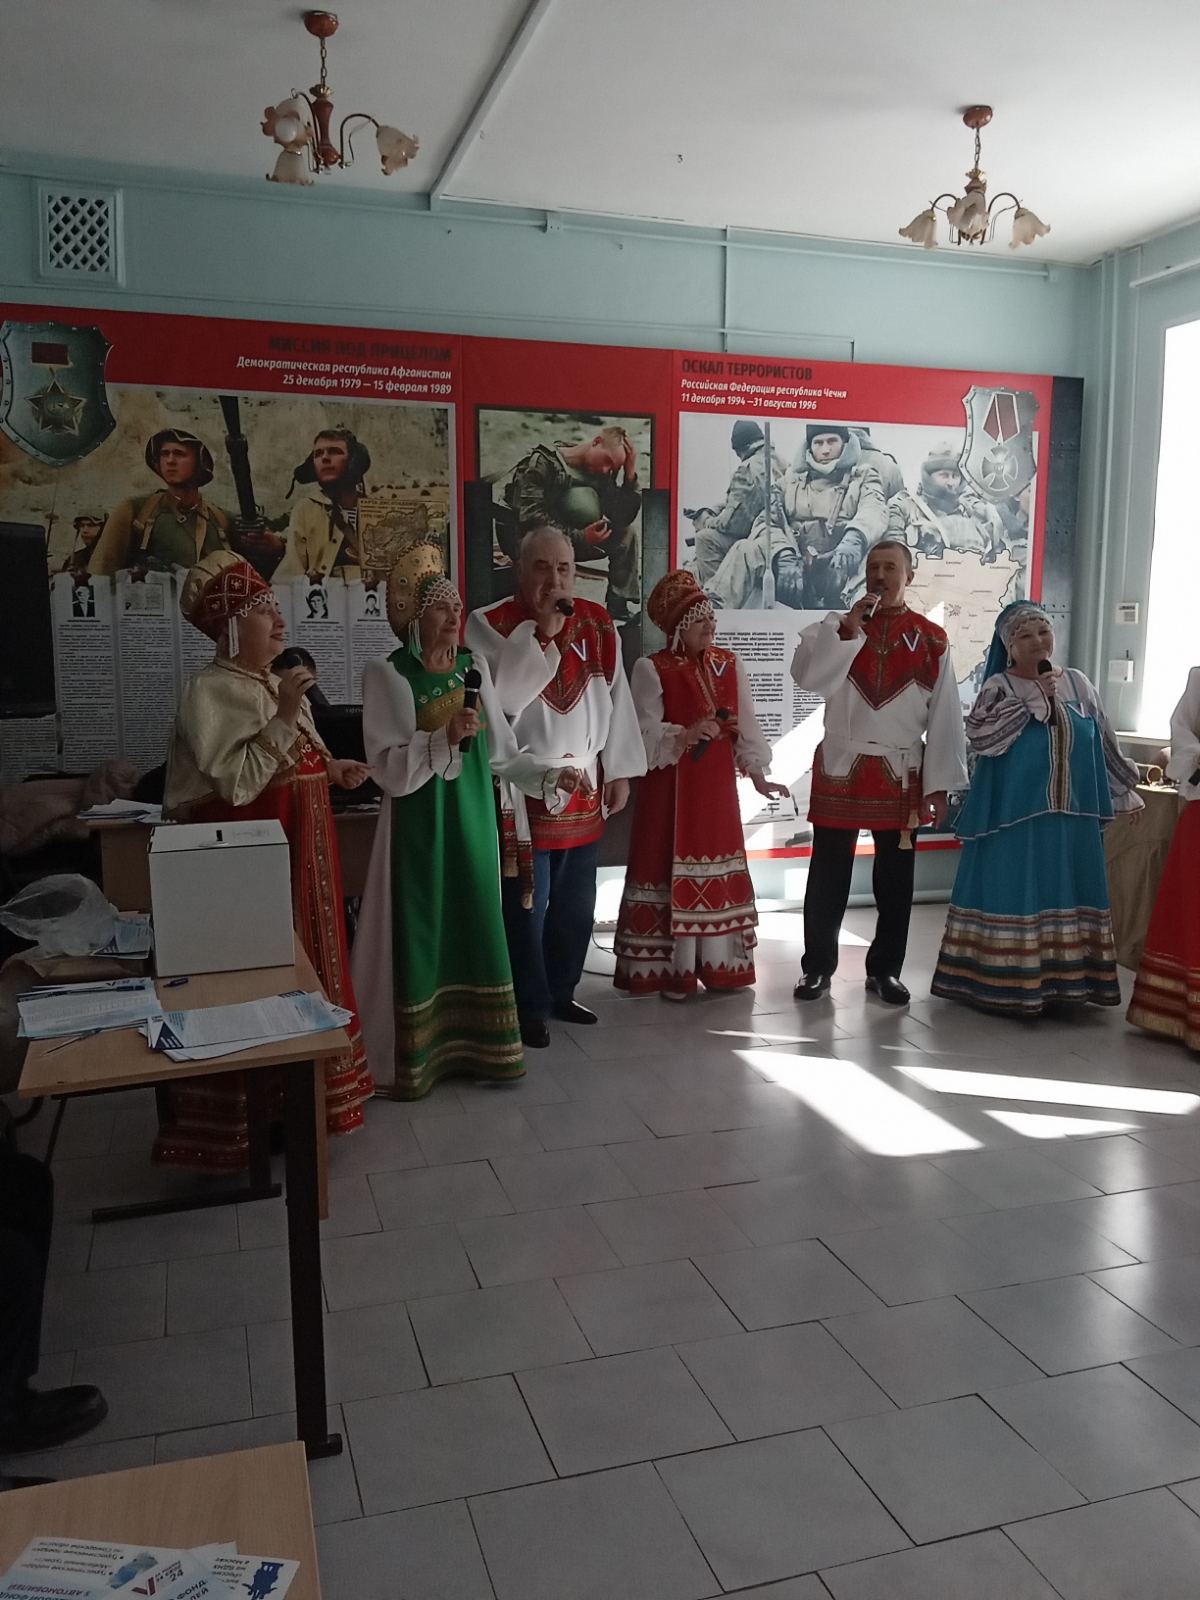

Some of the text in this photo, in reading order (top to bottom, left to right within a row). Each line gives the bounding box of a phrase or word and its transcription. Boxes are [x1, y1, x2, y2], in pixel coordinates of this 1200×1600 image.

[237, 356, 452, 380] Демократическая республика Афганистан
[682, 358, 813, 381] ОСКАЛ ТЕРРОРИСТОВ
[283, 374, 294, 385] 25
[296, 375, 338, 388] декабря
[340, 378, 361, 389] 1979
[374, 380, 384, 390] 15
[385, 381, 428, 394] февраля
[430, 383, 452, 395] 1989
[681, 379, 847, 399] Российская Федерация республика Чечня
[681, 393, 690, 402] 11
[691, 394, 726, 406] декабря
[727, 396, 746, 406] 1994
[764, 400, 797, 410] августа
[798, 400, 817, 410] 1996
